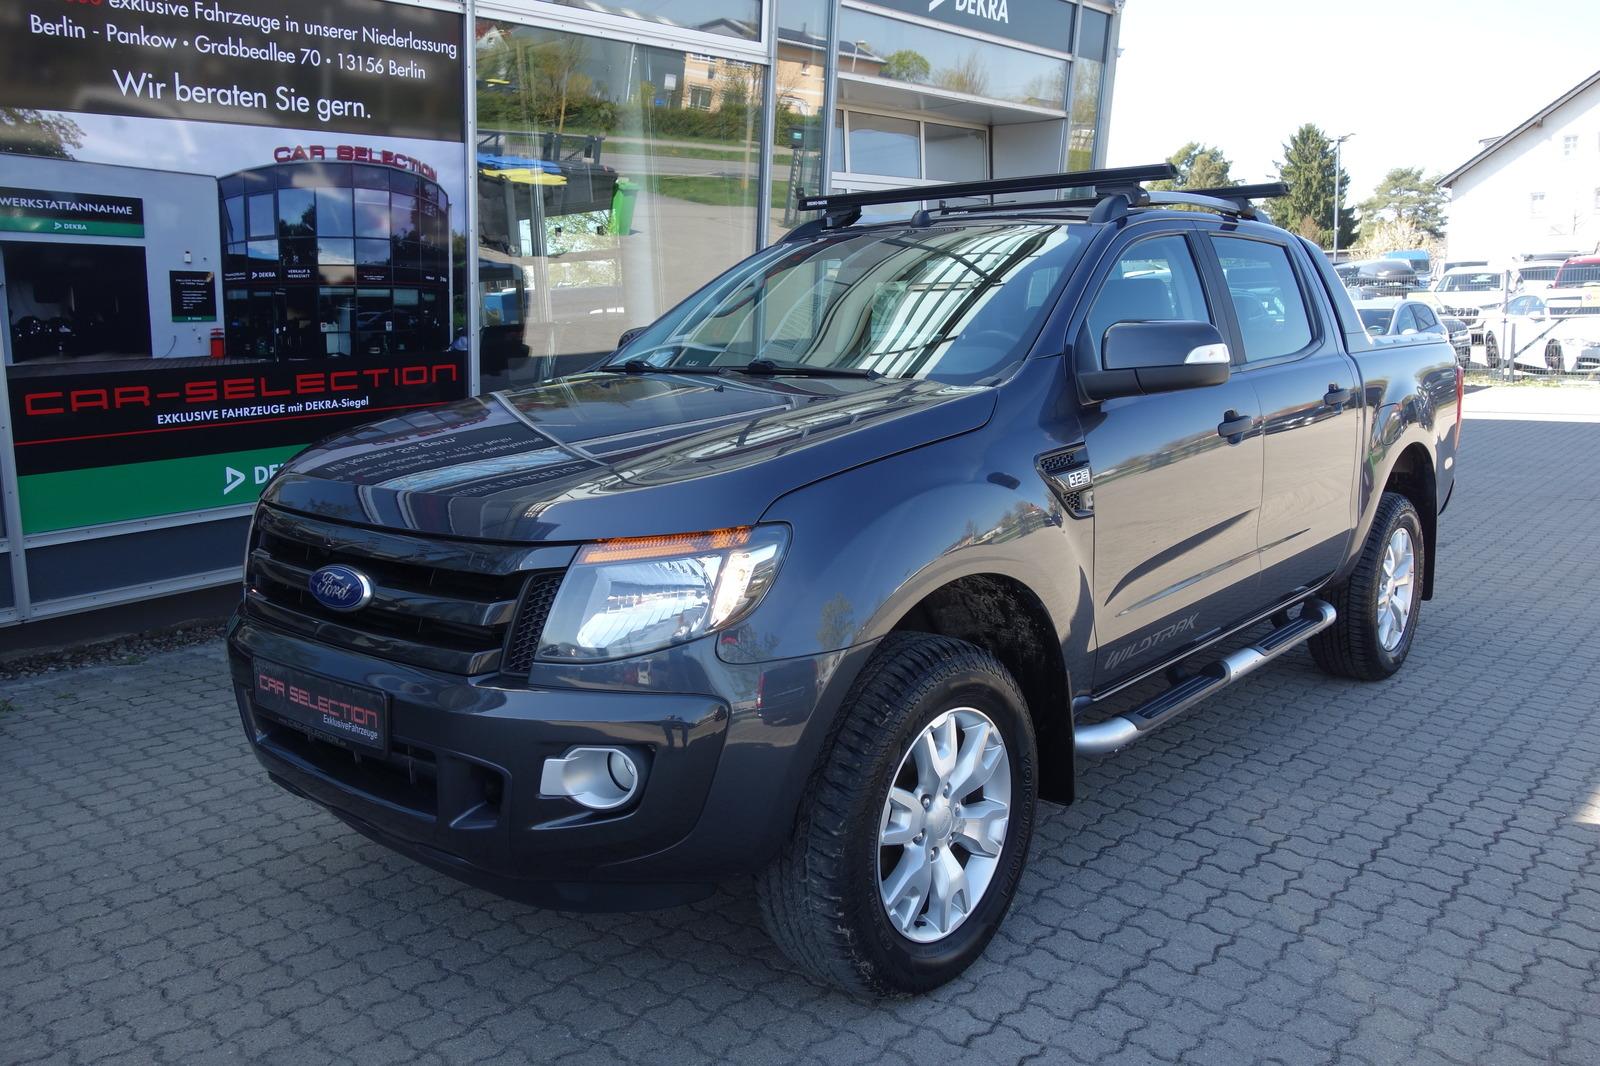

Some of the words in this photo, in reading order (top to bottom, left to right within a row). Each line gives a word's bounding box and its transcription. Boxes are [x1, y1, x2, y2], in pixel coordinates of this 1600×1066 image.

[30, 14, 86, 39] Berlin
[106, 23, 177, 49] Pankow
[194, 35, 296, 64] Grabbeallee
[300, 48, 321, 67] 70
[337, 53, 385, 74] 13156
[388, 59, 426, 80] Berlin
[109, 0, 189, 17] exklusive
[195, 1, 280, 33] Fahrzeuge
[285, 15, 300, 33] in
[304, 22, 359, 41] unserer
[363, 26, 458, 59] Niederlassung
[112, 69, 166, 100] Wir
[175, 72, 267, 109] beraten
[275, 86, 310, 113] Sie
[316, 97, 372, 121] gern.
[273, 145, 326, 163] CAR
[336, 145, 438, 181] SELECTION
[0, 196, 133, 216] WERKSTATTANNAHME
[63, 222, 88, 231] DEKRA
[258, 271, 276, 279] DEKRA
[25, 364, 458, 416] CAR-SELECTION
[157, 409, 219, 425] EXKLUSIVE
[221, 404, 286, 420] FAHRZEUGE
[287, 401, 303, 414] mit
[304, 395, 370, 412] DEKRA-Siegel
[316, 571, 352, 600] Ford
[1104, 612, 1200, 670] WILDTRAK
[258, 674, 286, 697] CAR
[289, 686, 379, 729] SELECTION
